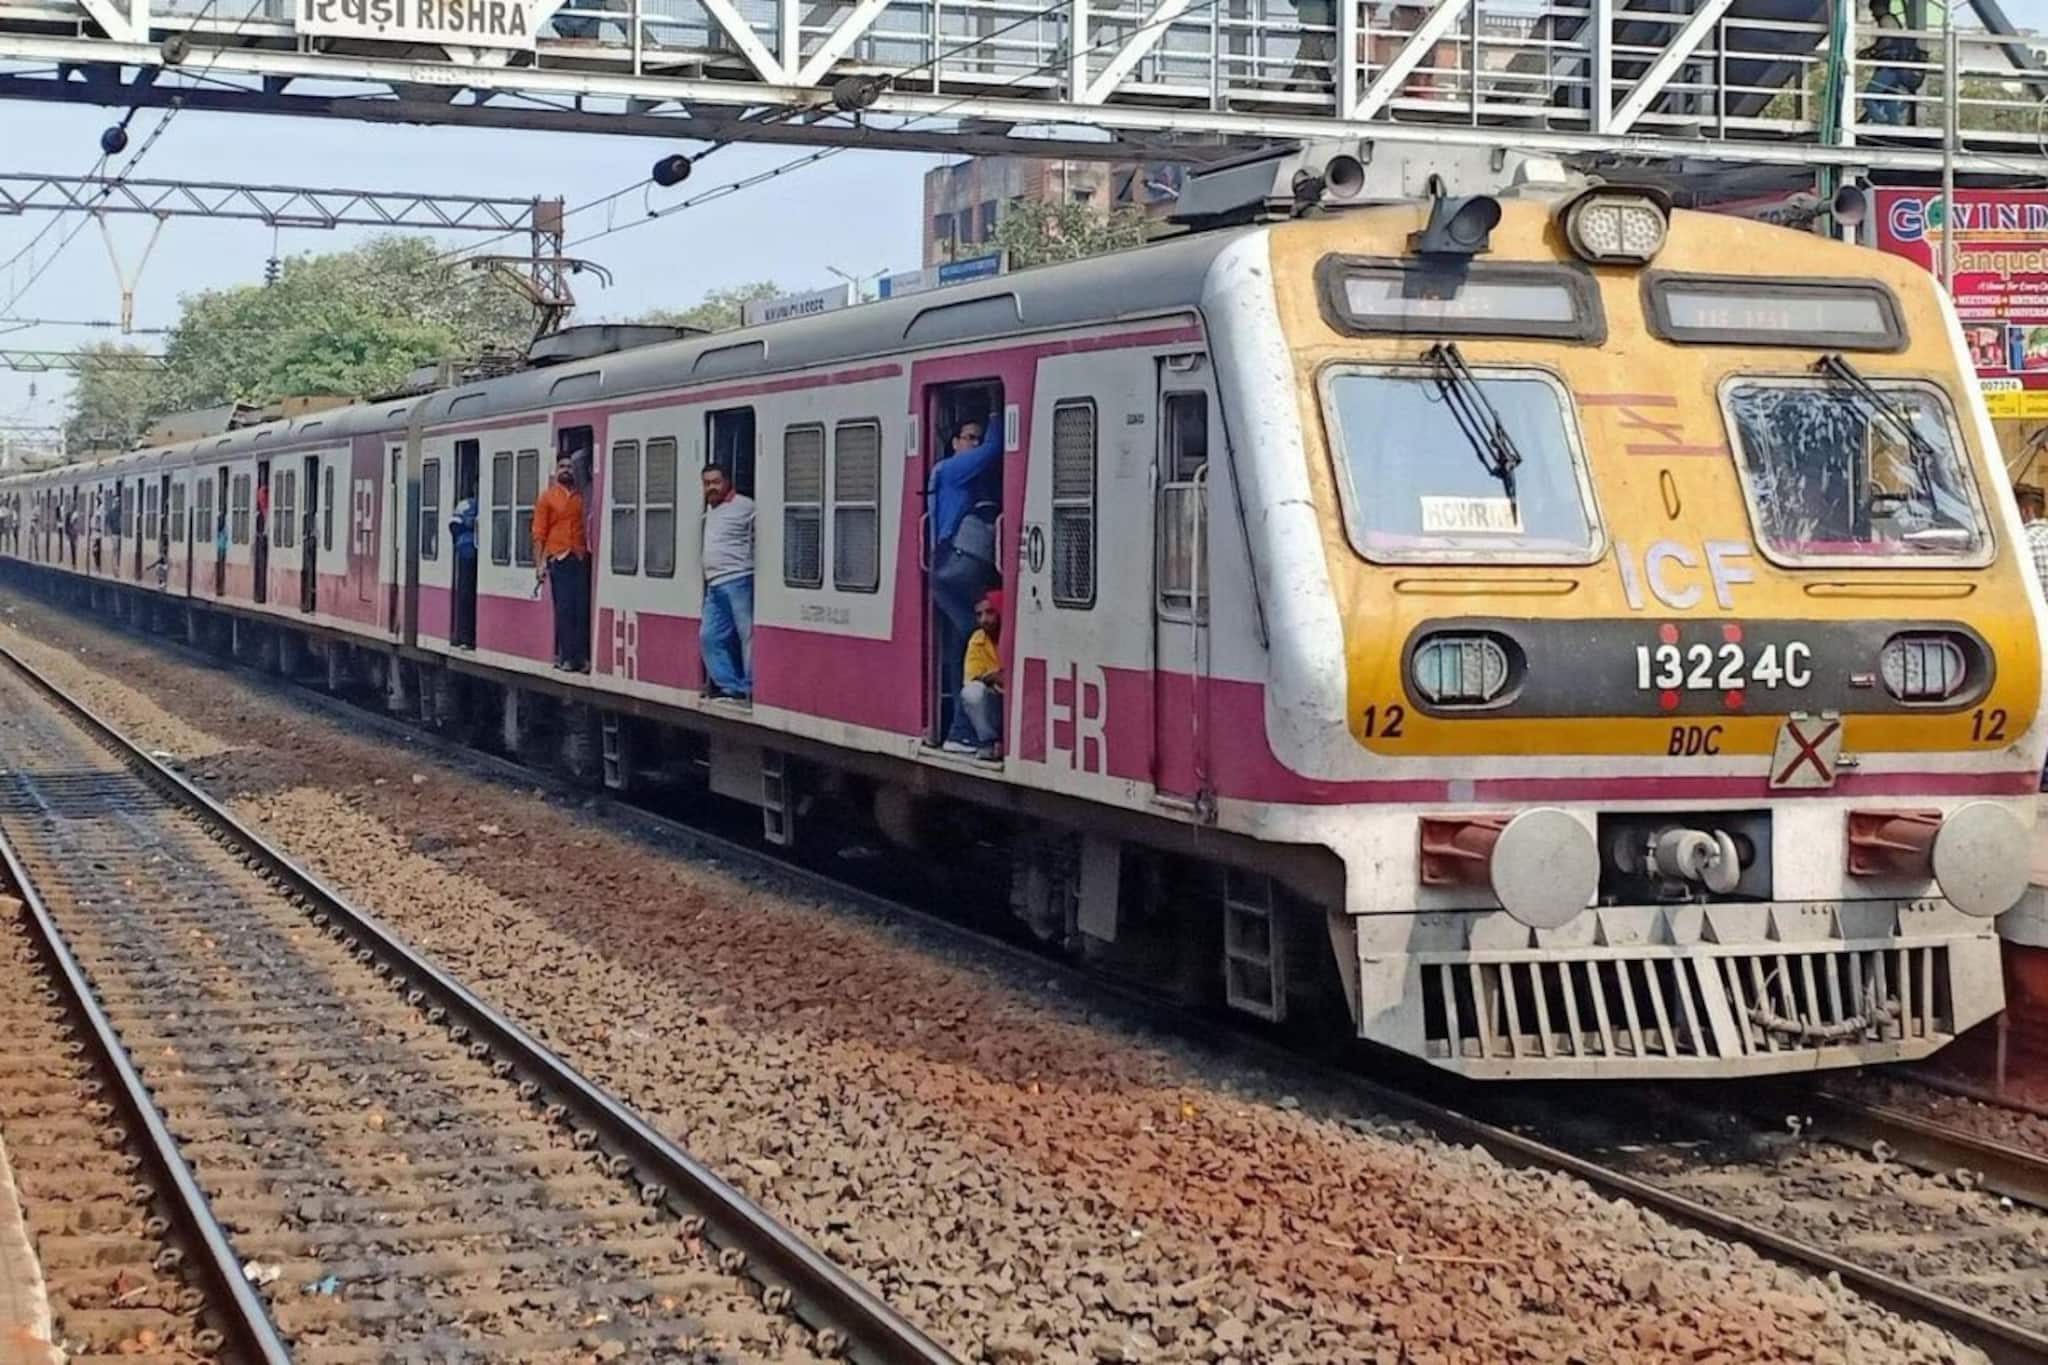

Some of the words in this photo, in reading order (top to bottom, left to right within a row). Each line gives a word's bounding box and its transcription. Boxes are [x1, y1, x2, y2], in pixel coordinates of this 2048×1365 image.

[416, 0, 527, 36] RISHRA
[1612, 538, 1756, 611] ICF
[613, 608, 639, 681] ER
[1635, 641, 1812, 690] 13224C
[1045, 660, 1108, 776] ER
[1363, 704, 1405, 738] 12
[1972, 709, 2007, 742] 12
[1667, 724, 1724, 757] BDC
